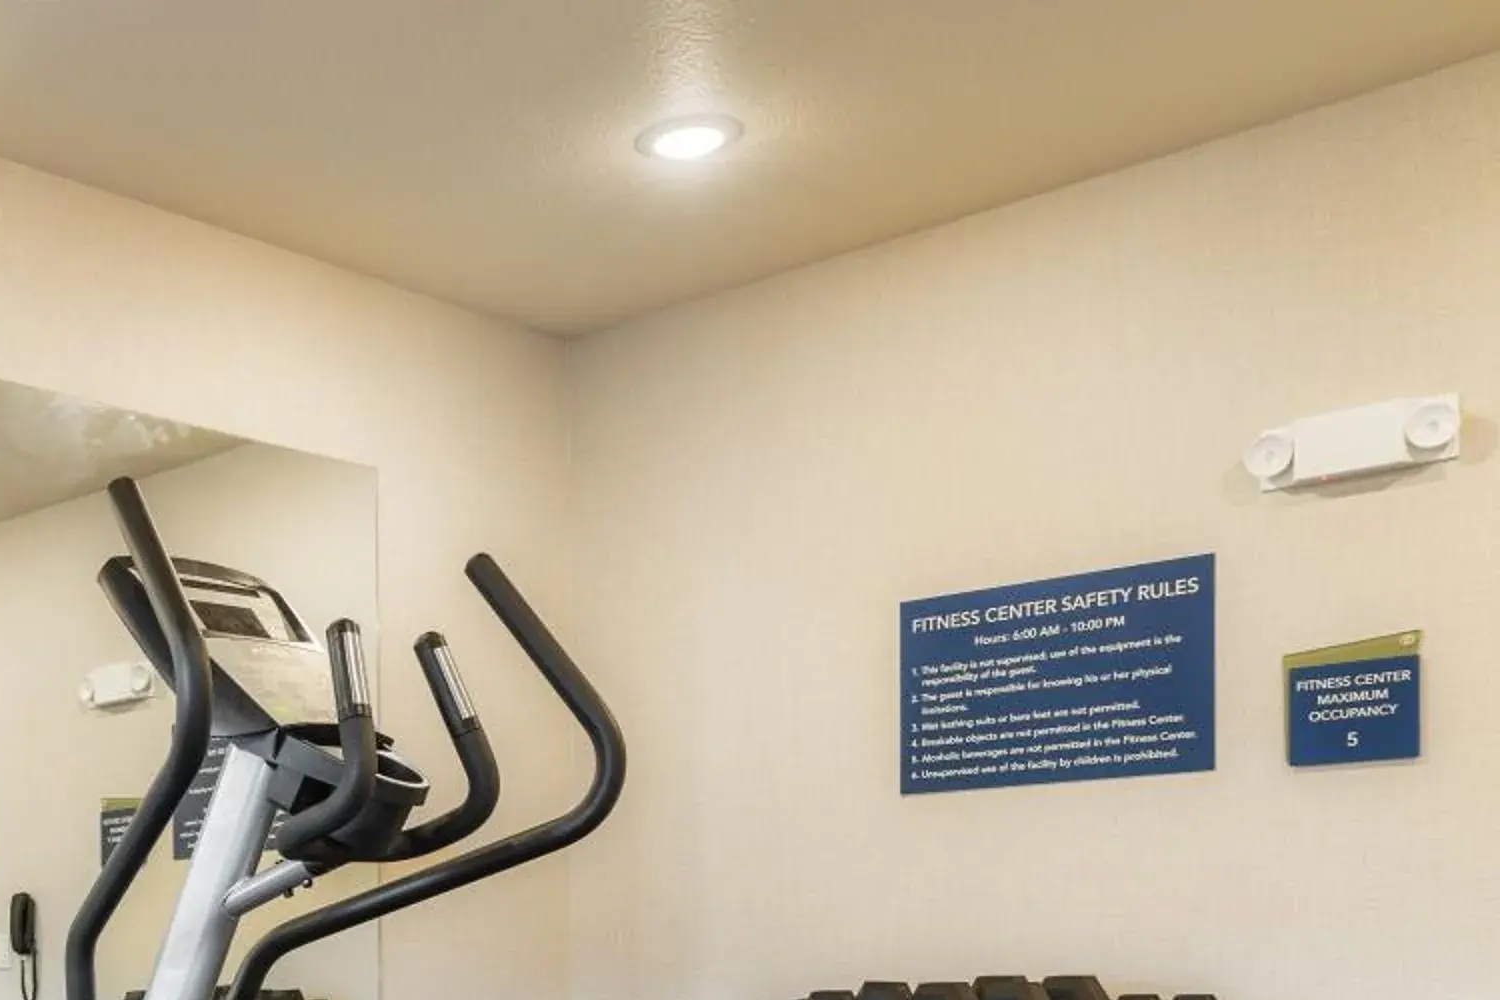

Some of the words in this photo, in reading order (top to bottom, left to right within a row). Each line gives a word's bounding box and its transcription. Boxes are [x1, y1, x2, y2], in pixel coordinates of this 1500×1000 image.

[911, 609, 980, 633] FITNESS
[985, 599, 1057, 623] CENTER
[1061, 587, 1133, 612] SAFETY
[1137, 577, 1199, 600] RULES
[974, 633, 1010, 646] Hours:
[1012, 627, 1037, 641] 6:00
[1039, 624, 1060, 637] AM
[1070, 618, 1103, 633] 10:00
[1105, 615, 1125, 628] PM
[969, 660, 977, 669] is
[980, 658, 994, 669] not
[1049, 650, 1066, 659] use
[1068, 645, 1078, 656] of
[1080, 645, 1097, 655] the
[1099, 638, 1151, 653] equipment
[1153, 635, 1162, 645] is
[1164, 633, 1182, 643] the
[921, 692, 937, 702] The
[940, 690, 963, 702] guest
[965, 687, 973, 697] is
[974, 682, 1026, 696] responsible
[1027, 680, 1040, 691] for
[1043, 676, 1082, 689] knowing
[1100, 673, 1111, 681] or
[1113, 669, 1129, 680] her
[1131, 663, 1172, 681] physical
[991, 668, 1006, 678] the
[1297, 675, 1350, 692] FITNESS
[1355, 669, 1412, 685] CENTER
[1317, 688, 1389, 705] MAXIMUM
[940, 718, 975, 729] bathing
[976, 715, 996, 725] suits
[998, 715, 1008, 723] or
[1009, 711, 1031, 723] bare
[1053, 708, 1068, 717] are
[1070, 706, 1087, 716] not
[1308, 704, 1398, 723] OCCUPANCY
[921, 734, 964, 747] Breakable
[965, 732, 998, 744] objects
[1000, 731, 1015, 741] are
[1016, 728, 1031, 738] not
[1033, 723, 1081, 739] permitted
[1082, 721, 1091, 731] in
[1093, 719, 1110, 730] the
[1112, 716, 1147, 728] Fitness
[1347, 731, 1359, 747] 5
[921, 750, 960, 763] Alcoholic
[962, 746, 1008, 760] beverages
[1009, 746, 1025, 756] are
[1026, 743, 1042, 753] not
[1044, 736, 1091, 755] permitted
[1093, 736, 1102, 746] in
[1104, 735, 1120, 746] the
[1123, 731, 1159, 744] Fitness
[921, 765, 980, 779] Unsupervised
[981, 765, 997, 774] use
[999, 762, 1008, 772] of
[1010, 760, 1026, 771] the
[1028, 757, 1057, 771] facility
[1059, 757, 1071, 769] by
[1074, 755, 1112, 766] children
[1113, 754, 1122, 763] is
